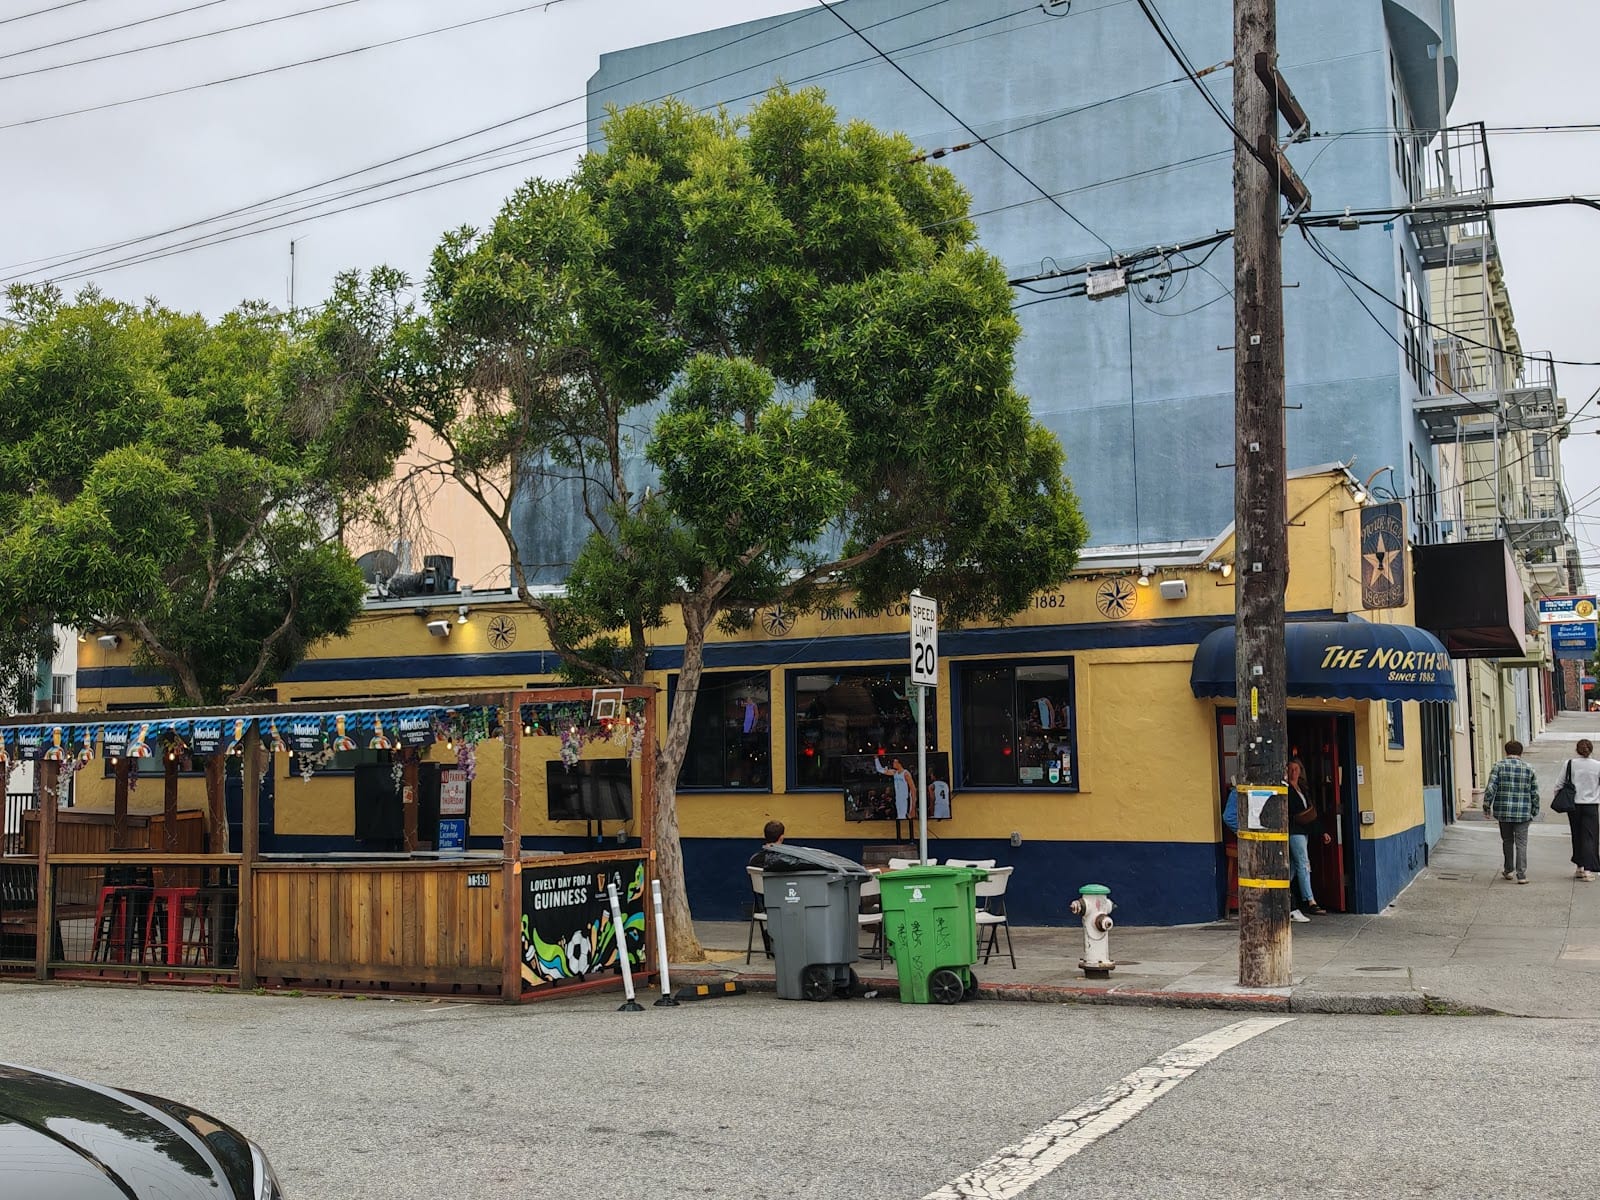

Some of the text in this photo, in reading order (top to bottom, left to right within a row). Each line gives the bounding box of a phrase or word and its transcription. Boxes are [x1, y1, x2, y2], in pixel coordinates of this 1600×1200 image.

[1035, 595, 1066, 609] 1882
[912, 605, 935, 622] SPEED
[915, 623, 933, 640] LIMIT
[914, 642, 935, 675] 20
[1320, 645, 1369, 669] THE
[1367, 647, 1435, 671] NORTH
[1388, 670, 1437, 683] SINCE 1882
[293, 723, 320, 736] Modelo
[400, 718, 429, 731] Modelo
[194, 727, 220, 739] Modelo
[439, 821, 458, 832] Pay by
[439, 831, 458, 839] License
[439, 839, 452, 847] Plate
[530, 874, 592, 892] LOVELY DAY FOR A
[534, 887, 587, 910] GUINNESS
